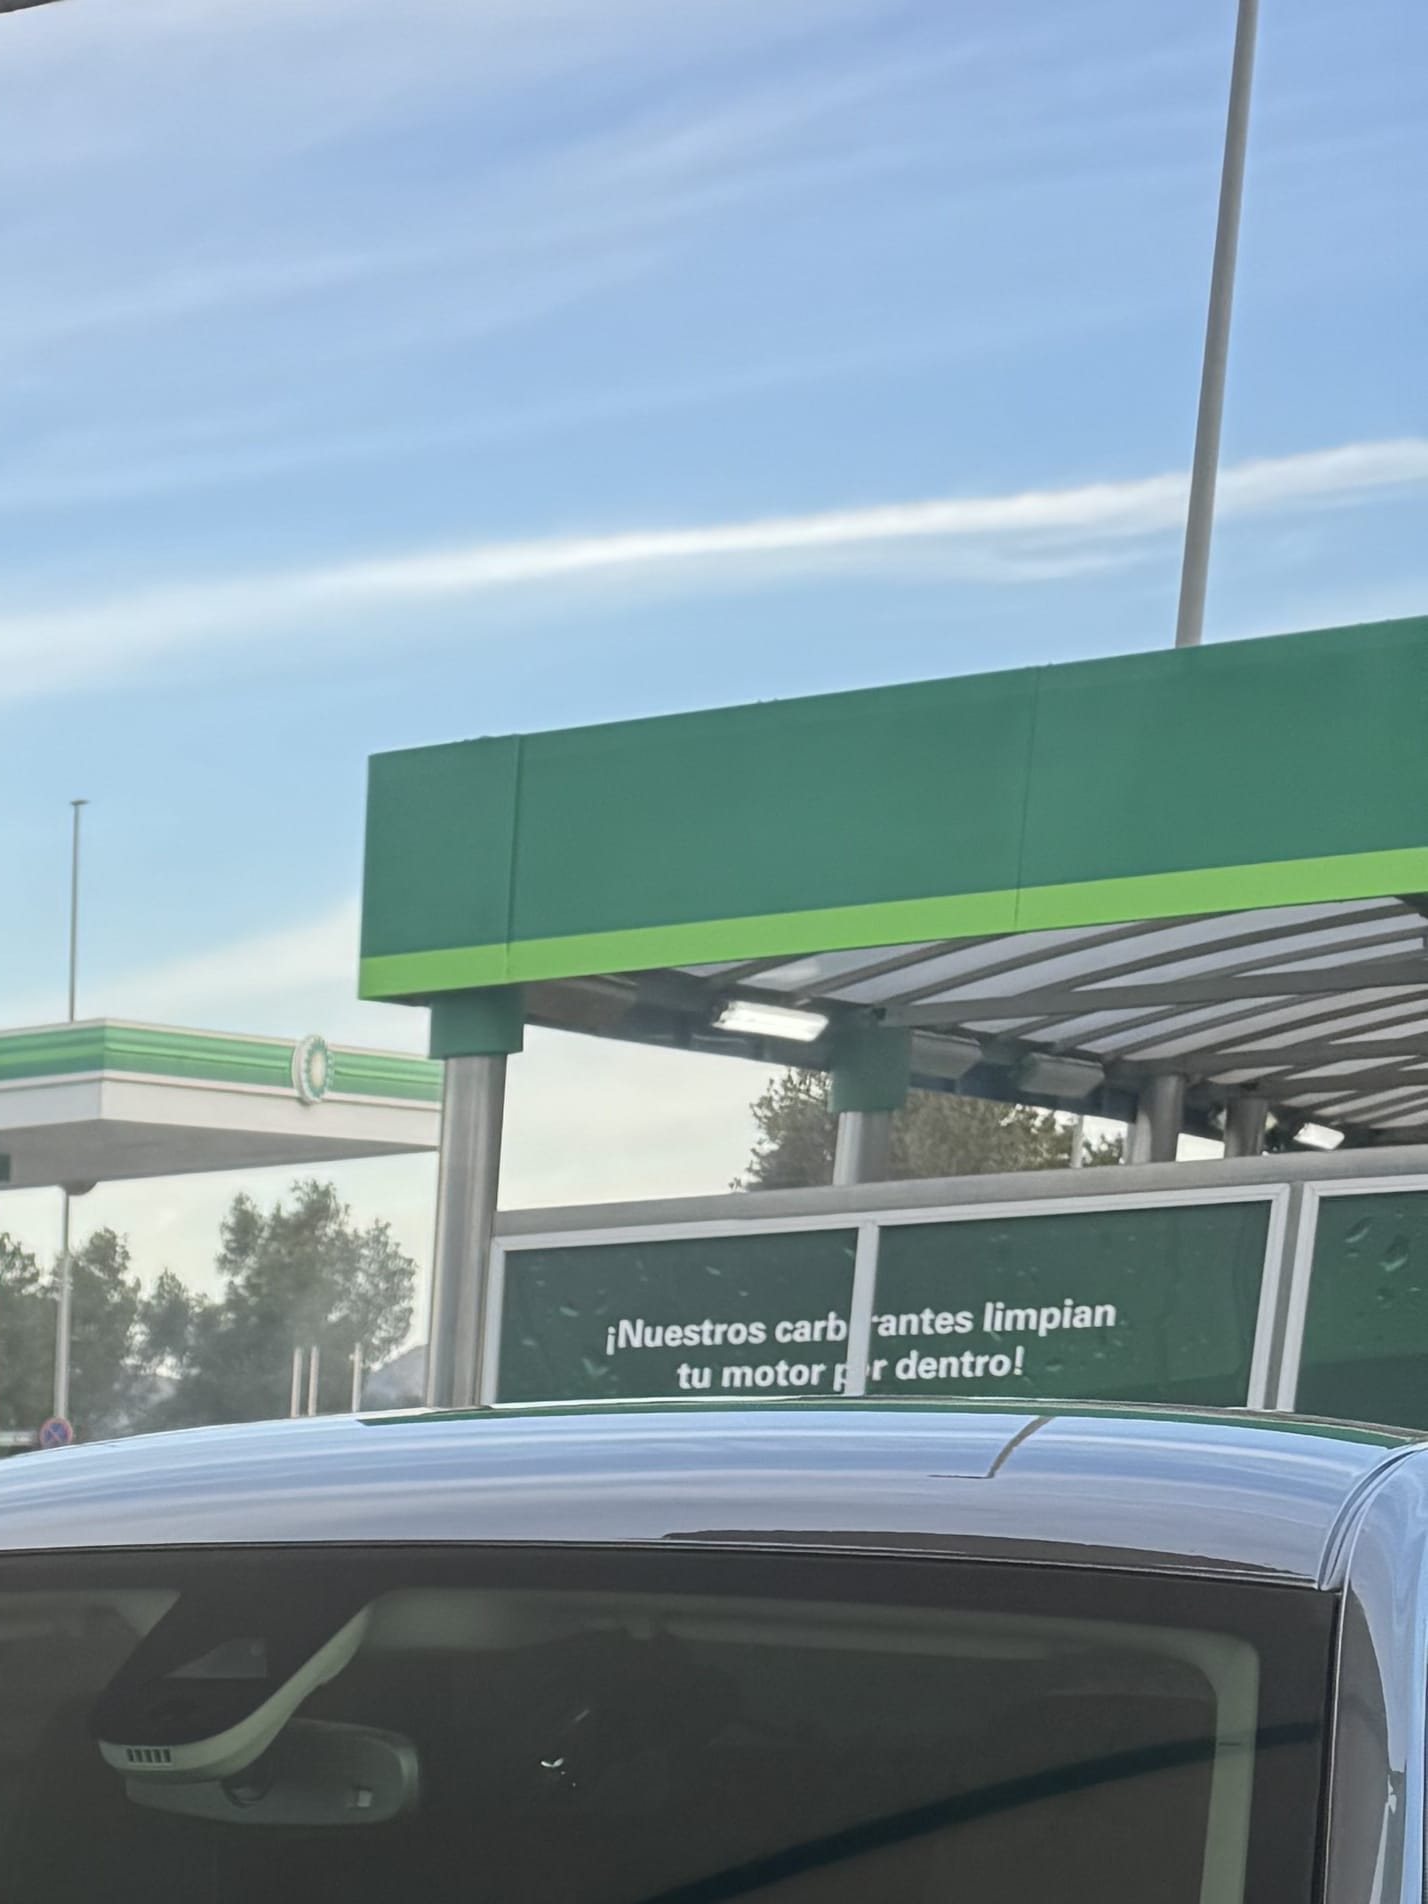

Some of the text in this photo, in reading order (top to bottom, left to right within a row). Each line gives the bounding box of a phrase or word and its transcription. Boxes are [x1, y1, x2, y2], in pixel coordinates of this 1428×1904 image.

[606, 1298, 1117, 1355] ¡Nuestros carbantes limpian
[677, 1346, 1025, 1392] tu motor pr dentro!
